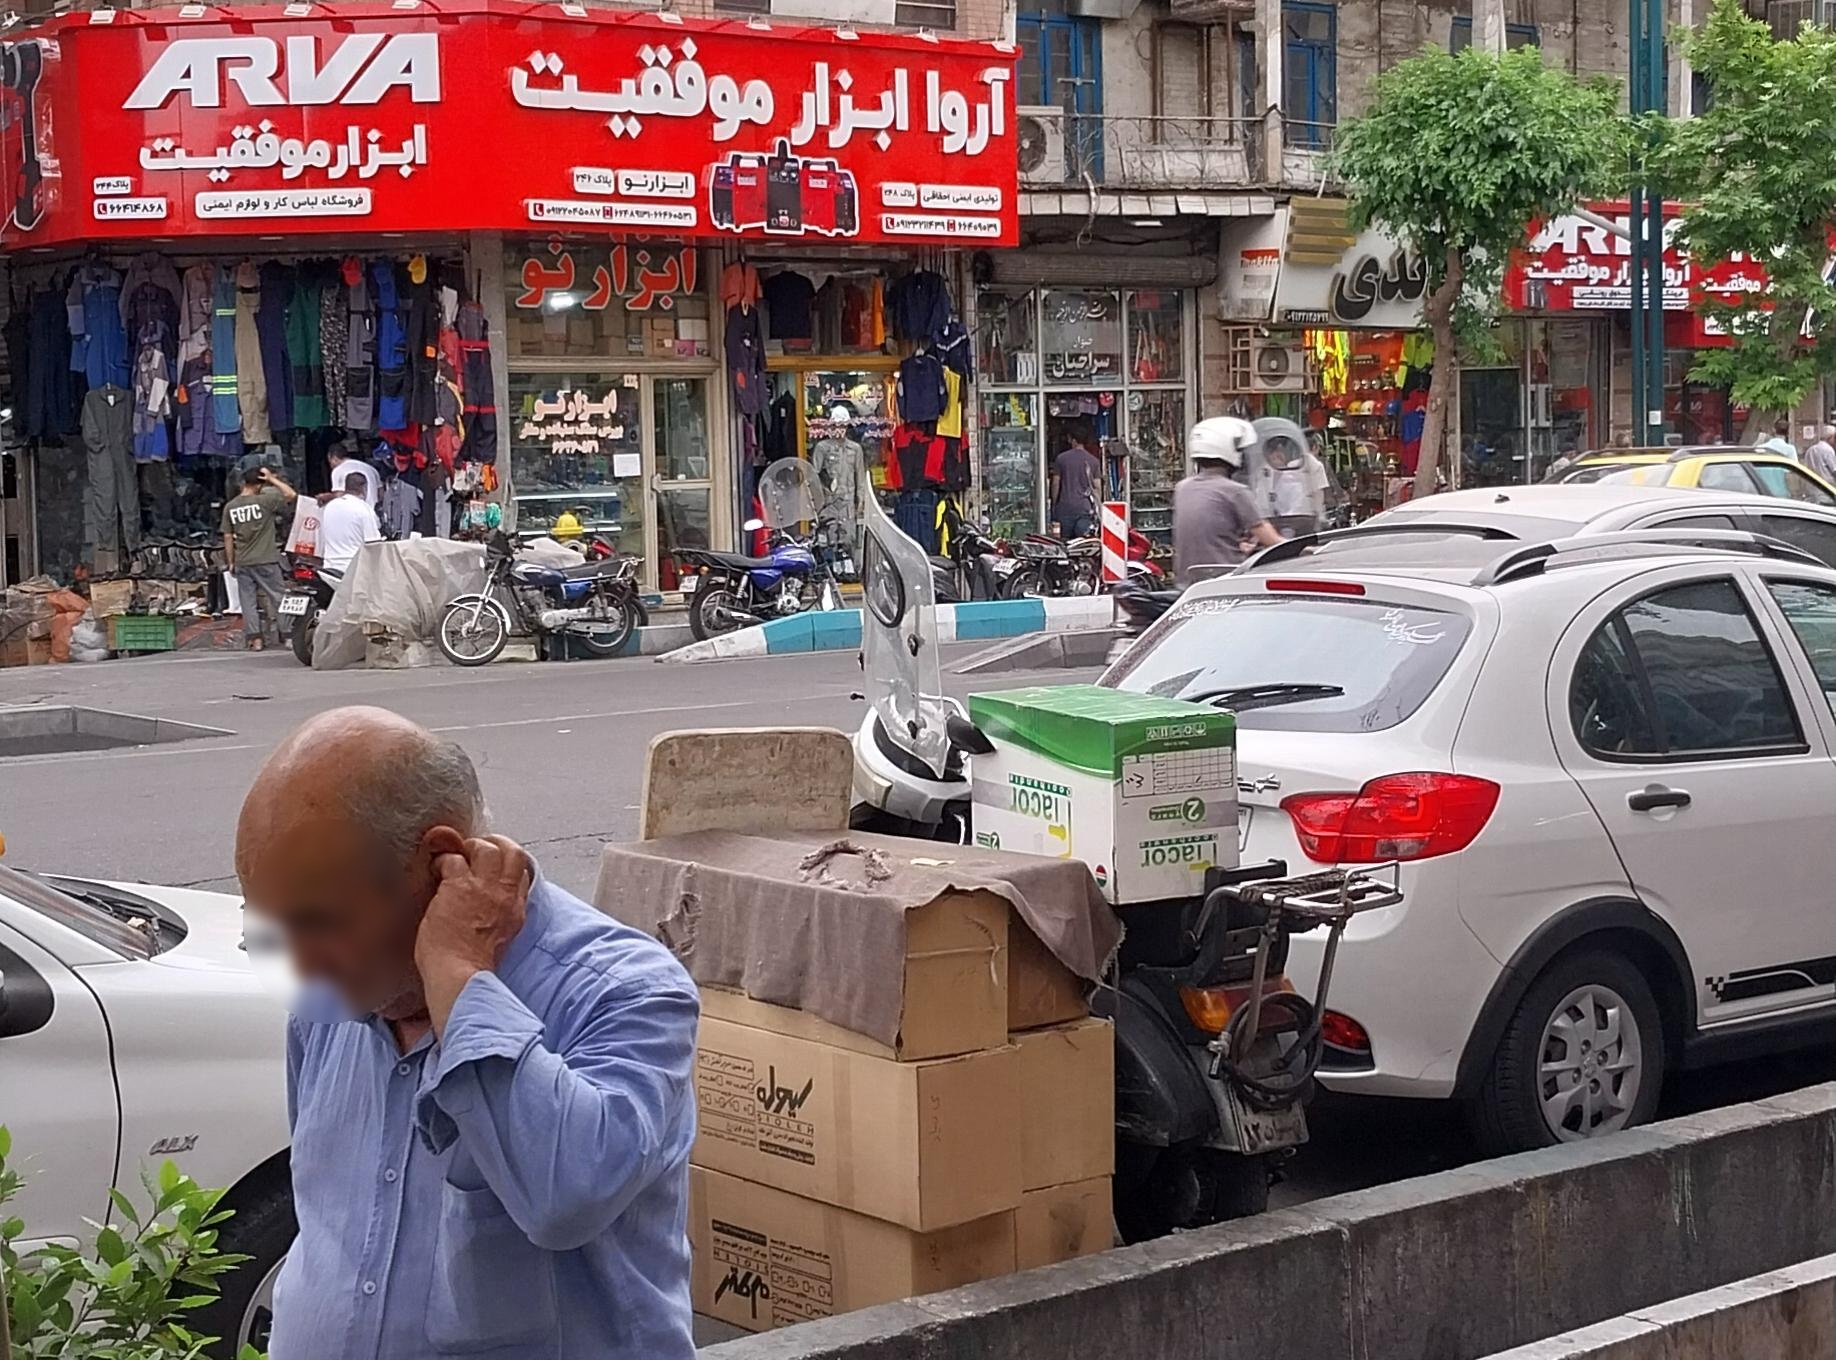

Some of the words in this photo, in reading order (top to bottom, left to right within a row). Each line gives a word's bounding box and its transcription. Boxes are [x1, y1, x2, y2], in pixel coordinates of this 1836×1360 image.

[122, 32, 441, 109] ARVA
[511, 37, 774, 140] موفقیت
[791, 62, 908, 151] ابزار
[926, 66, 1010, 155] آروا
[203, 200, 232, 212] ایمنی
[235, 198, 260, 212] لوازم
[264, 200, 270, 211] و
[272, 196, 288, 211] کار
[291, 196, 318, 210] لباس
[321, 193, 364, 208] فروشگاه
[1525, 256, 1610, 286] موفقیت
[230, 504, 262, 525] FG7C
